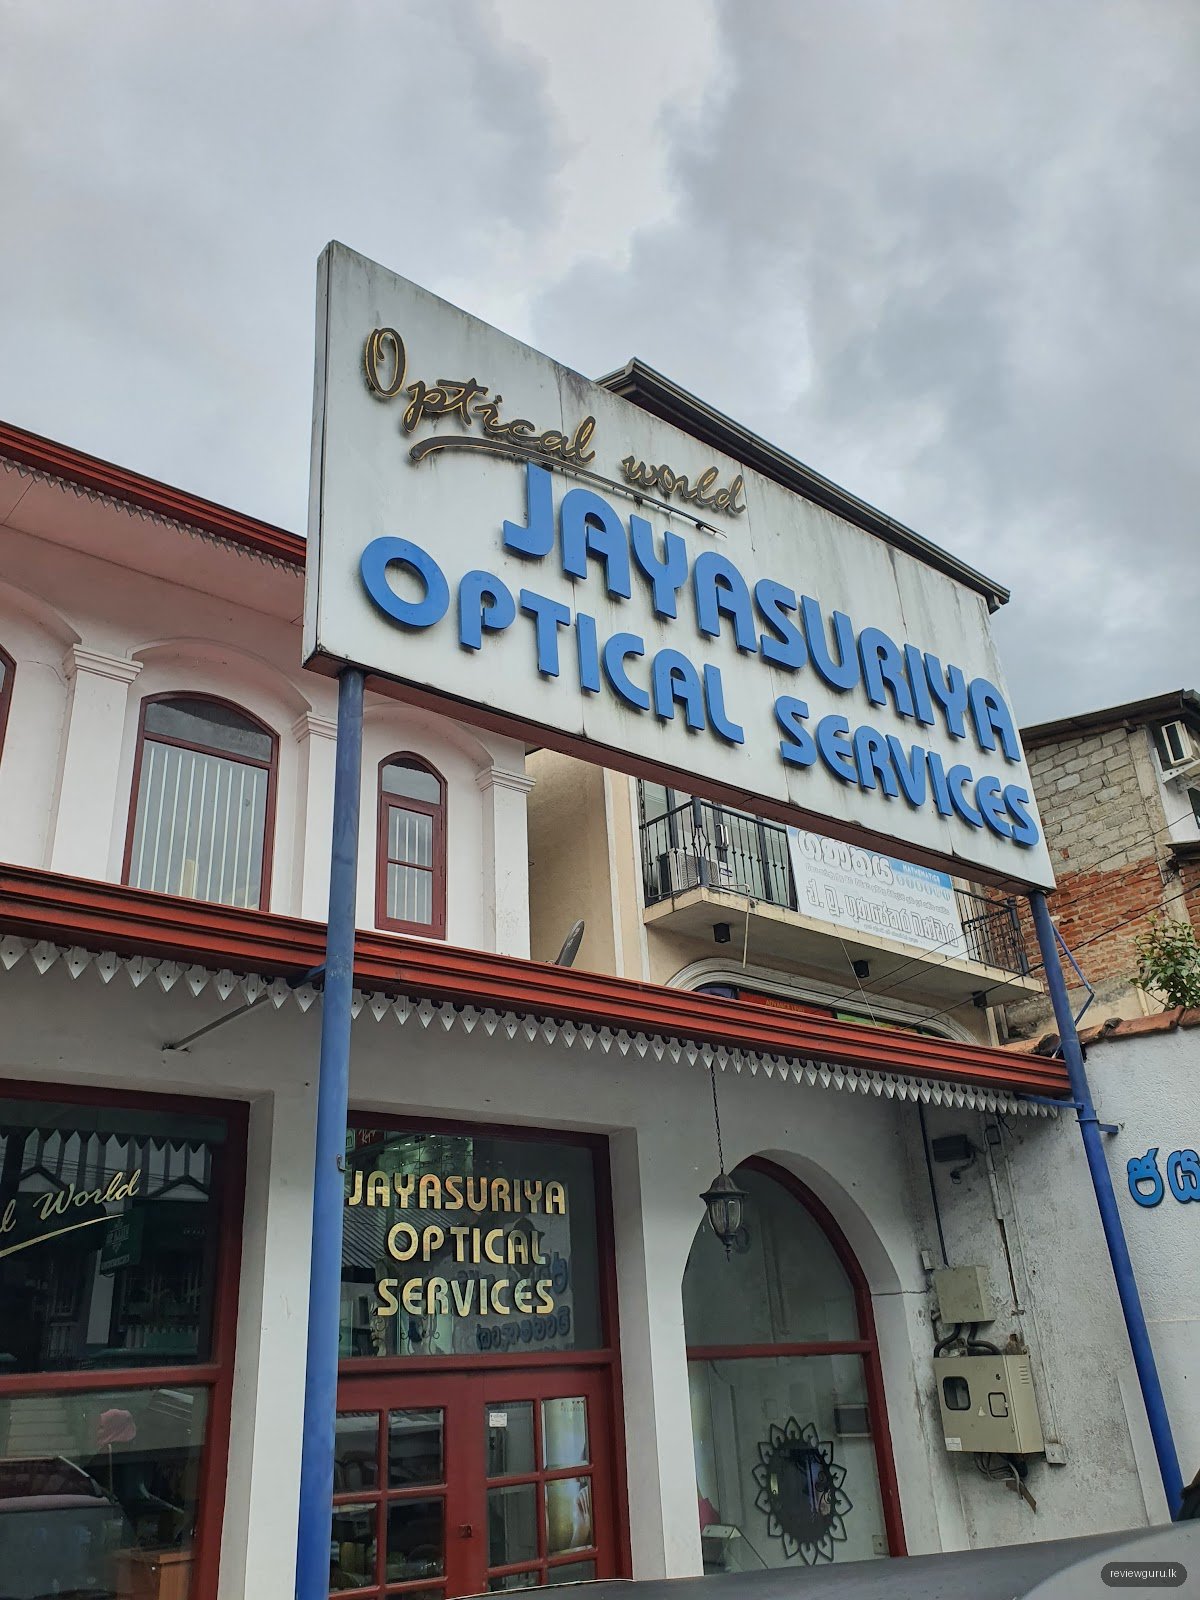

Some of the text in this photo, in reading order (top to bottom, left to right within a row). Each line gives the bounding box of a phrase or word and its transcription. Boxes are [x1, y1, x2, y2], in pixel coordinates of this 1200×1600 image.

[364, 327, 747, 515] Optical world
[503, 462, 1022, 763] JAYASURIYA
[361, 536, 1040, 847] OPTICAL SERVICES
[32, 1168, 141, 1220] World
[348, 1170, 566, 1215] JAYASURIYA
[388, 1221, 547, 1265] OPTICAL
[377, 1277, 555, 1317] SERVICES
